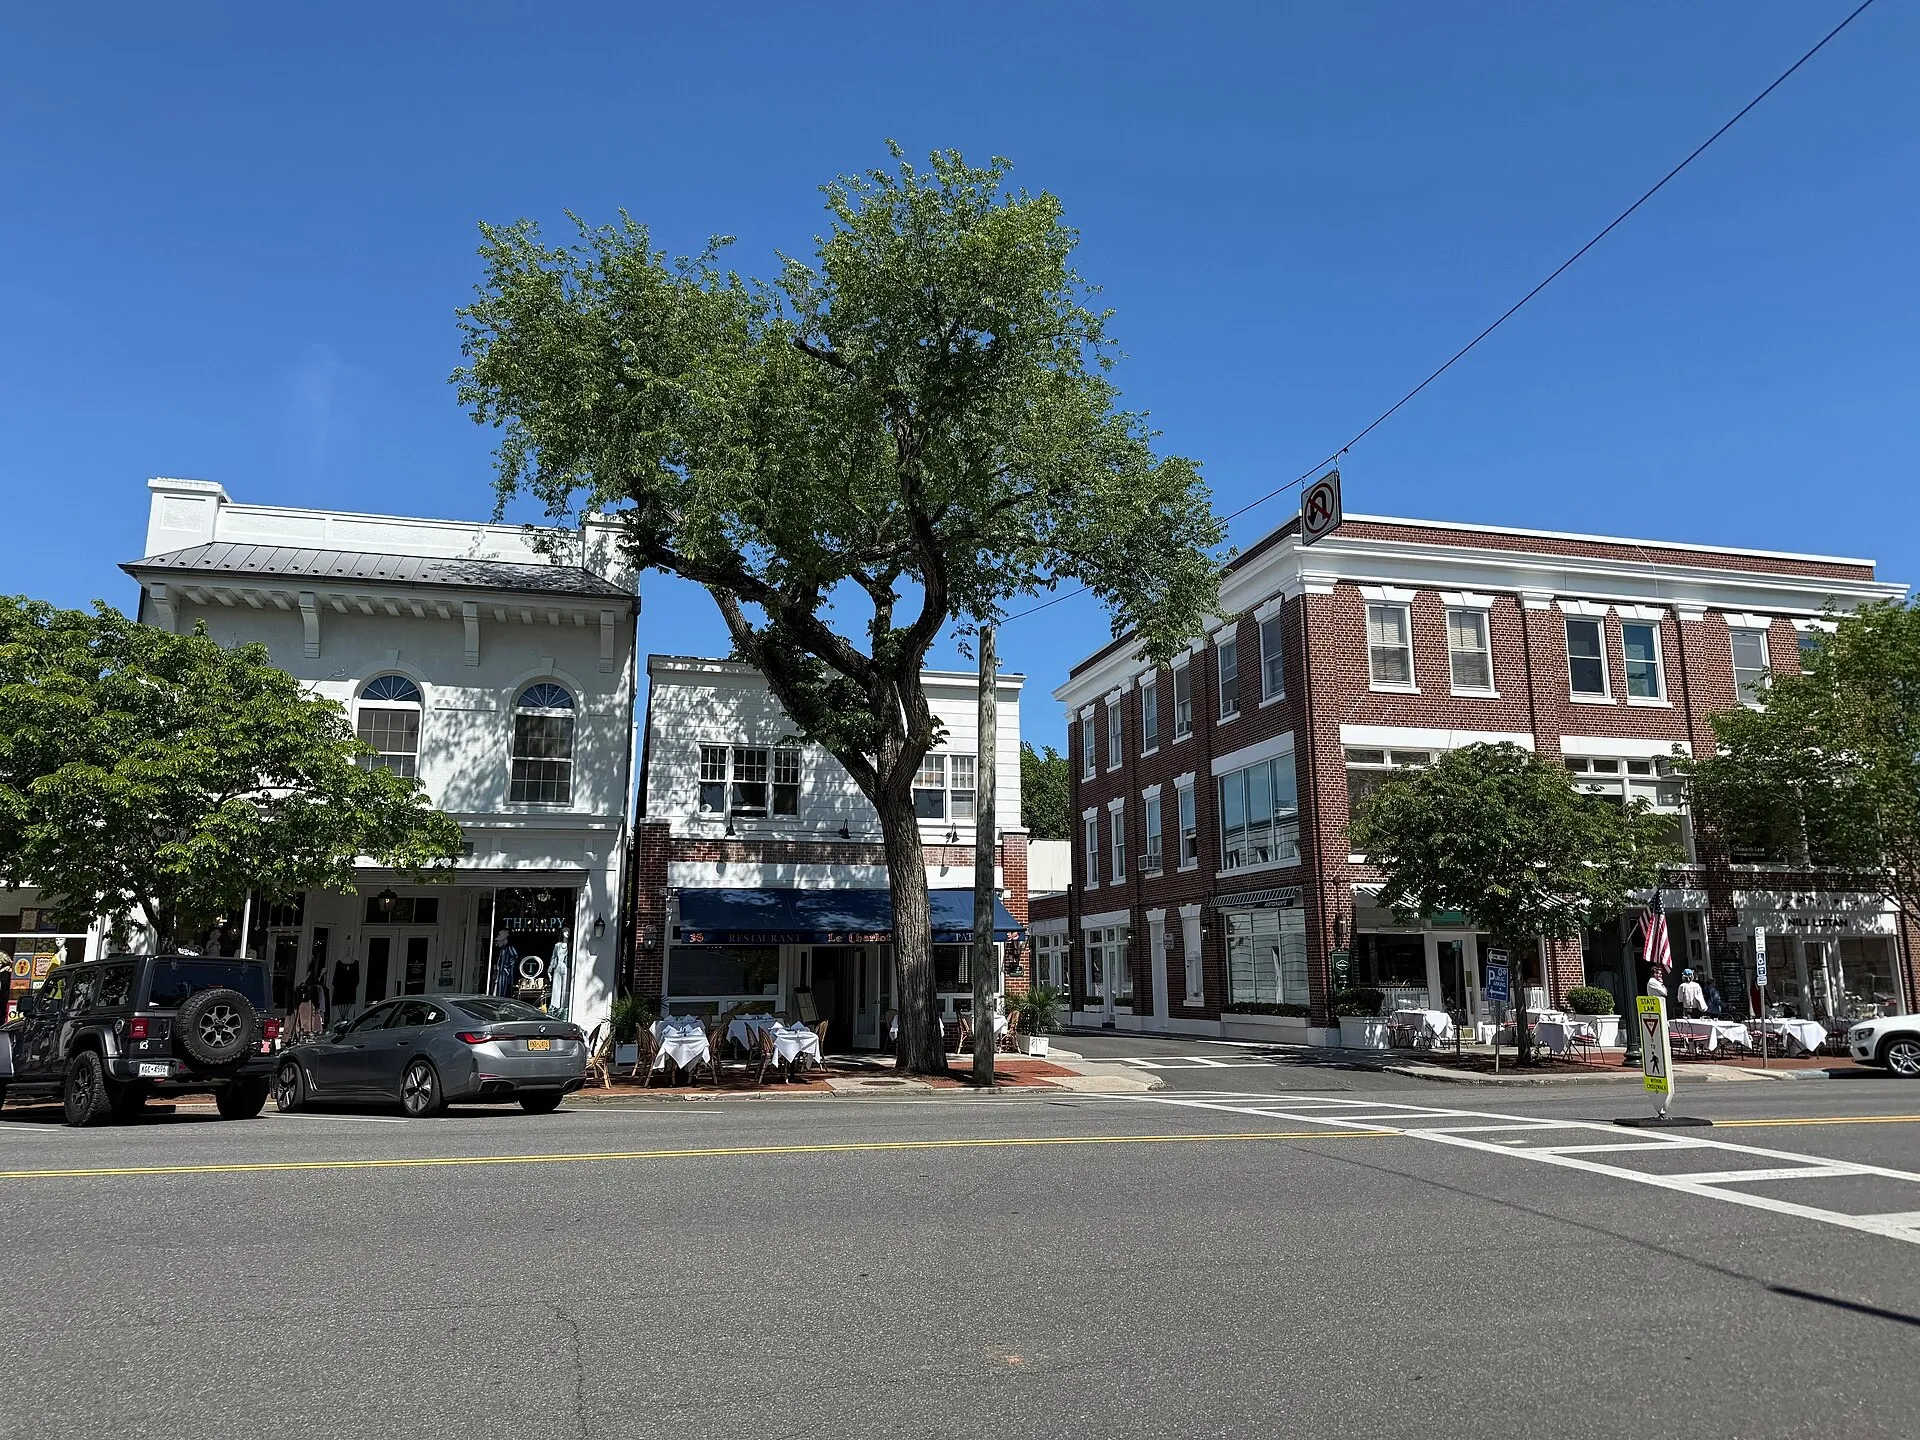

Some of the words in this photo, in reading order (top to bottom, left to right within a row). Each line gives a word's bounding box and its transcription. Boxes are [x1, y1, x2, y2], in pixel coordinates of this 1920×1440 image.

[502, 917, 566, 928] THERAPY
[1788, 918, 1808, 926] NILI
[1812, 918, 1848, 927] LOTAN
[728, 933, 801, 943] RESTAURANT
[827, 932, 843, 943] Le
